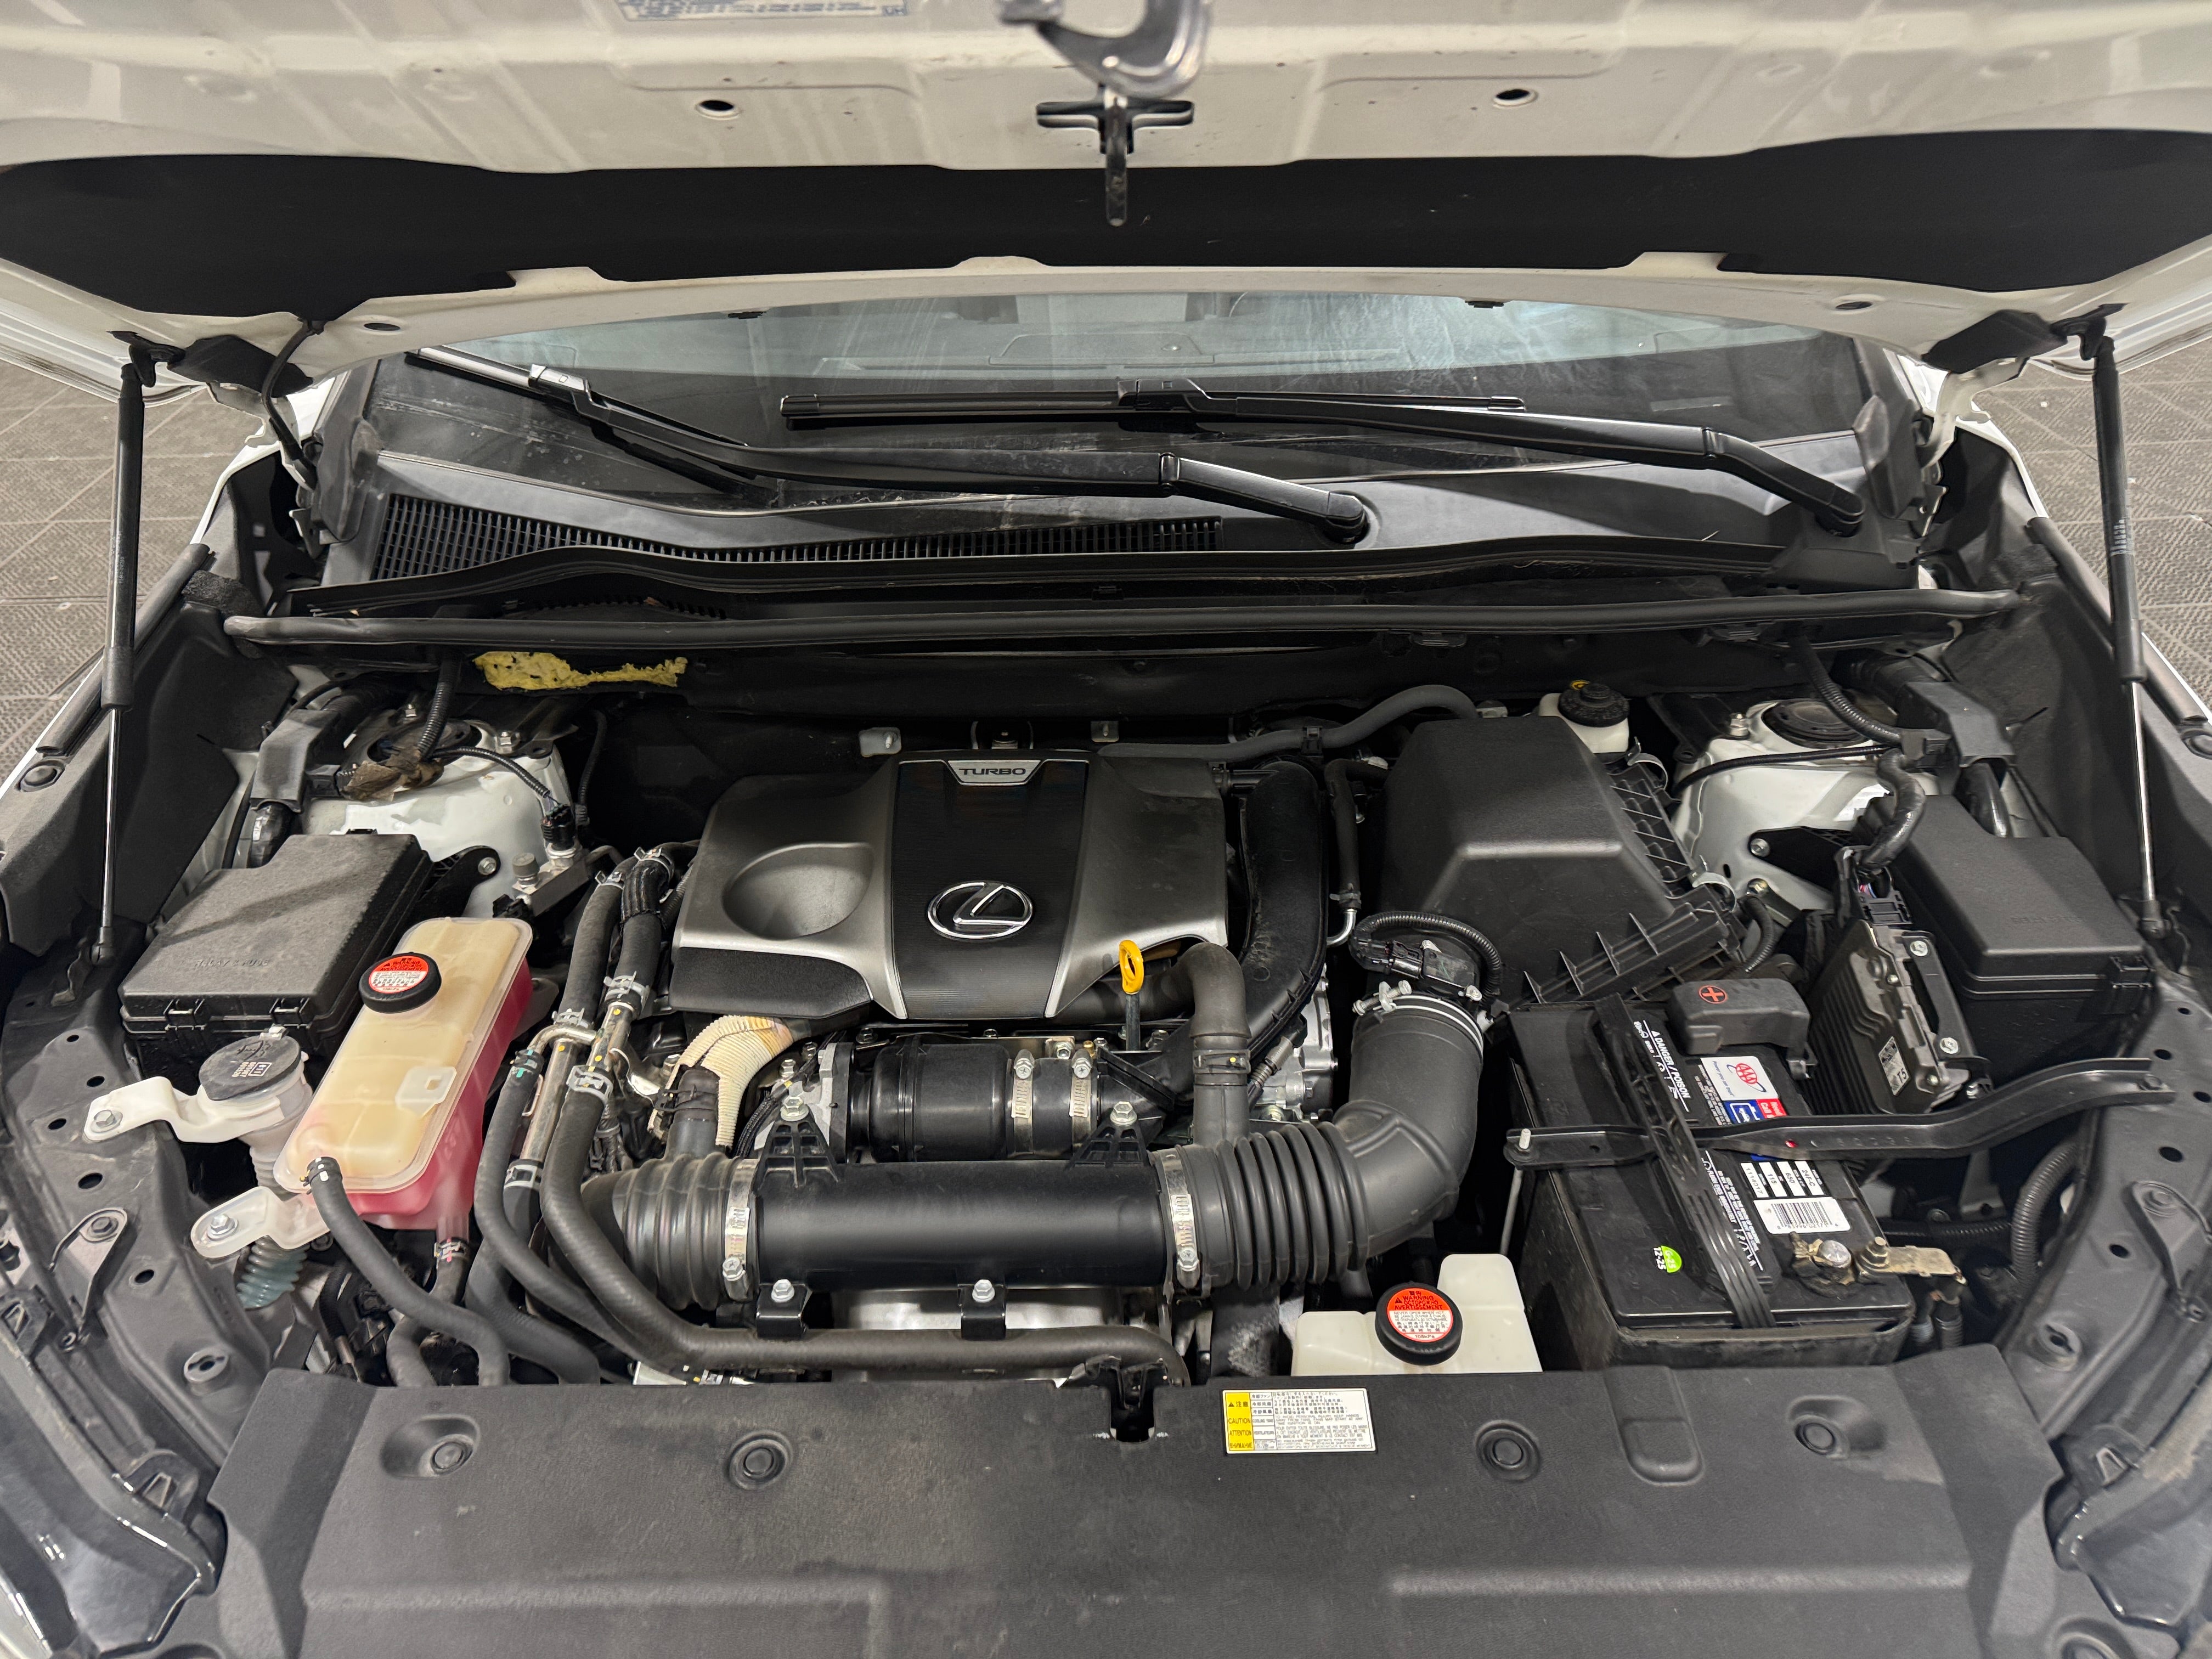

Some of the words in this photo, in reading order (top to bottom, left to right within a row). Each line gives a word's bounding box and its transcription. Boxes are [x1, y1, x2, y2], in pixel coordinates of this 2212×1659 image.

[1655, 1037, 1674, 1065] DANGER
[1671, 1071, 1691, 1098] POISON
[1737, 1064, 1757, 1084] AAA
[1760, 1102, 1773, 1114] Call
[1770, 1102, 1784, 1116] Need
[1746, 1167, 1763, 1194] 1114017
[1768, 1173, 1778, 1184] 115
[1785, 1172, 1795, 1184] 650
[1802, 1170, 1815, 1187] 24F-C
[1653, 1246, 1667, 1270] 12-25
